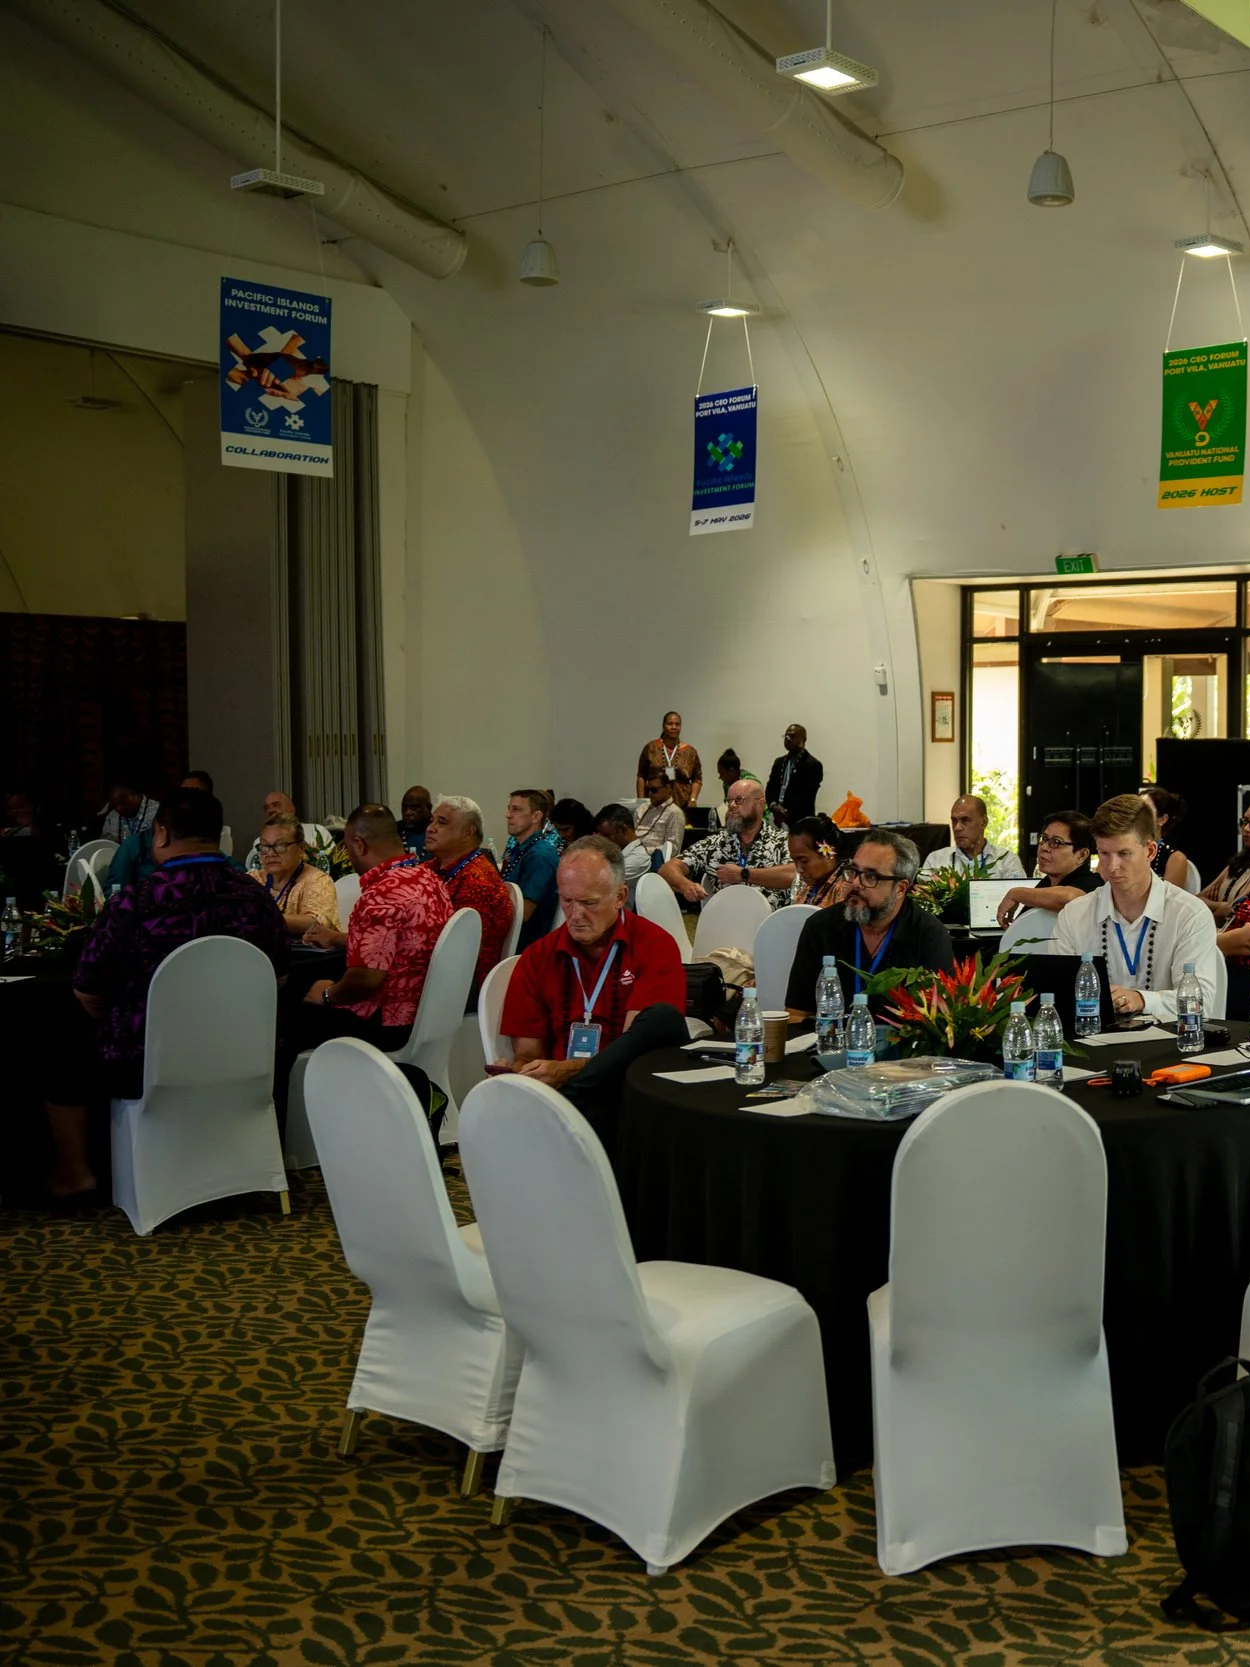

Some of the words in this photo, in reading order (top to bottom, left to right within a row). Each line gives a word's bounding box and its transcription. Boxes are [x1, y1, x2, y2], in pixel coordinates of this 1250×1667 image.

[231, 288, 274, 304] PACIFIC
[277, 297, 320, 312] ISLANDS
[224, 298, 289, 317] INVESTMENT
[292, 310, 328, 325] FORUM
[1168, 357, 1188, 366] 2026
[1190, 355, 1207, 363] CEO
[1209, 351, 1239, 361] FORUM
[1164, 366, 1185, 375] PORT
[1208, 359, 1246, 370] VANUATU
[699, 400, 713, 409] 2026
[714, 398, 728, 406] CEO
[729, 394, 751, 404] FORUM
[696, 408, 711, 418] PORT
[728, 401, 756, 412] VANUATU
[225, 445, 330, 464] COLLABORATION
[1166, 449, 1200, 459] VANUATU
[1201, 445, 1239, 456] NATIONAL
[1168, 456, 1212, 466] PROVIDENT
[1213, 455, 1235, 463] FUND
[732, 482, 754, 490] FORUM
[1162, 489, 1197, 500] 2026
[1200, 486, 1238, 497] HOST
[694, 519, 708, 527] 5-7
[729, 513, 751, 522] 2026
[1064, 560, 1084, 572] EXIT
